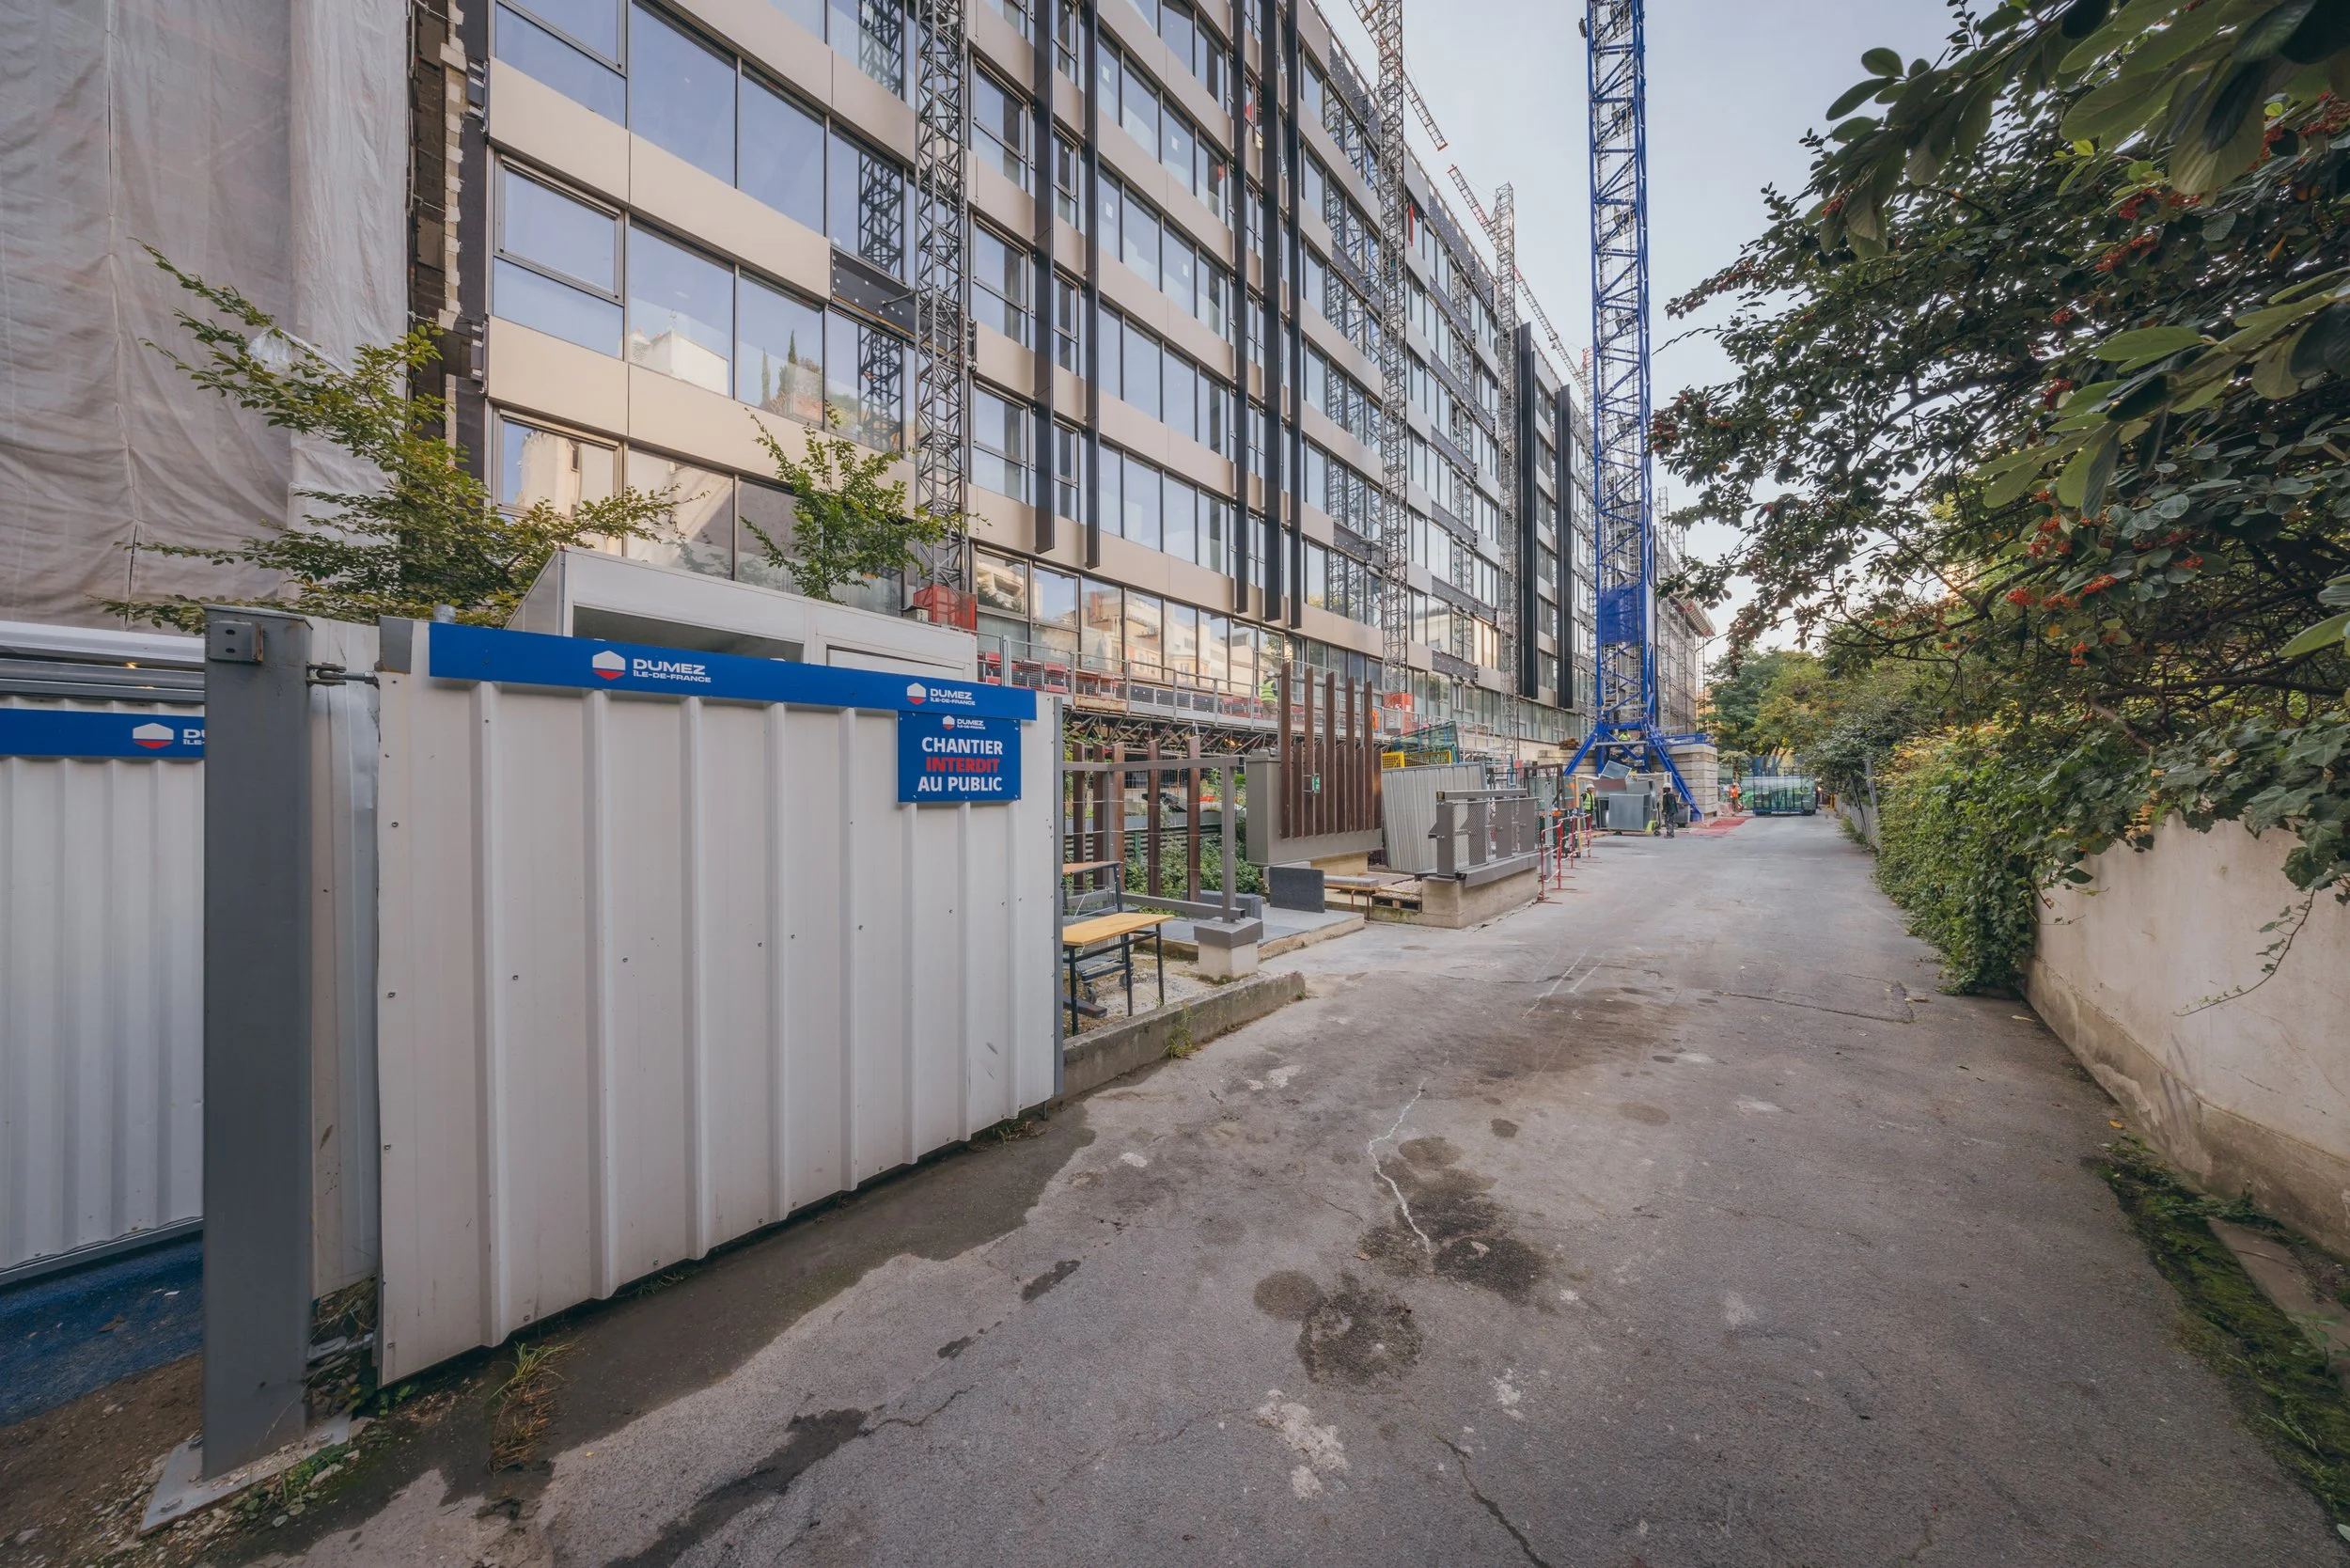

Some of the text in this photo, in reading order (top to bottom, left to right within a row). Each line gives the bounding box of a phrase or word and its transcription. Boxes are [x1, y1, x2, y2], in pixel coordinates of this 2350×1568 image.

[633, 658, 706, 675] DUMEZ
[633, 669, 712, 683] ÎLE-DE-FRANCE
[930, 688, 972, 700] DUMEZ
[957, 718, 984, 727] DUMEZ
[921, 736, 1003, 755] CHANTIER
[926, 757, 999, 773] INTERDIT
[917, 776, 1002, 792] AU PUBLIC
